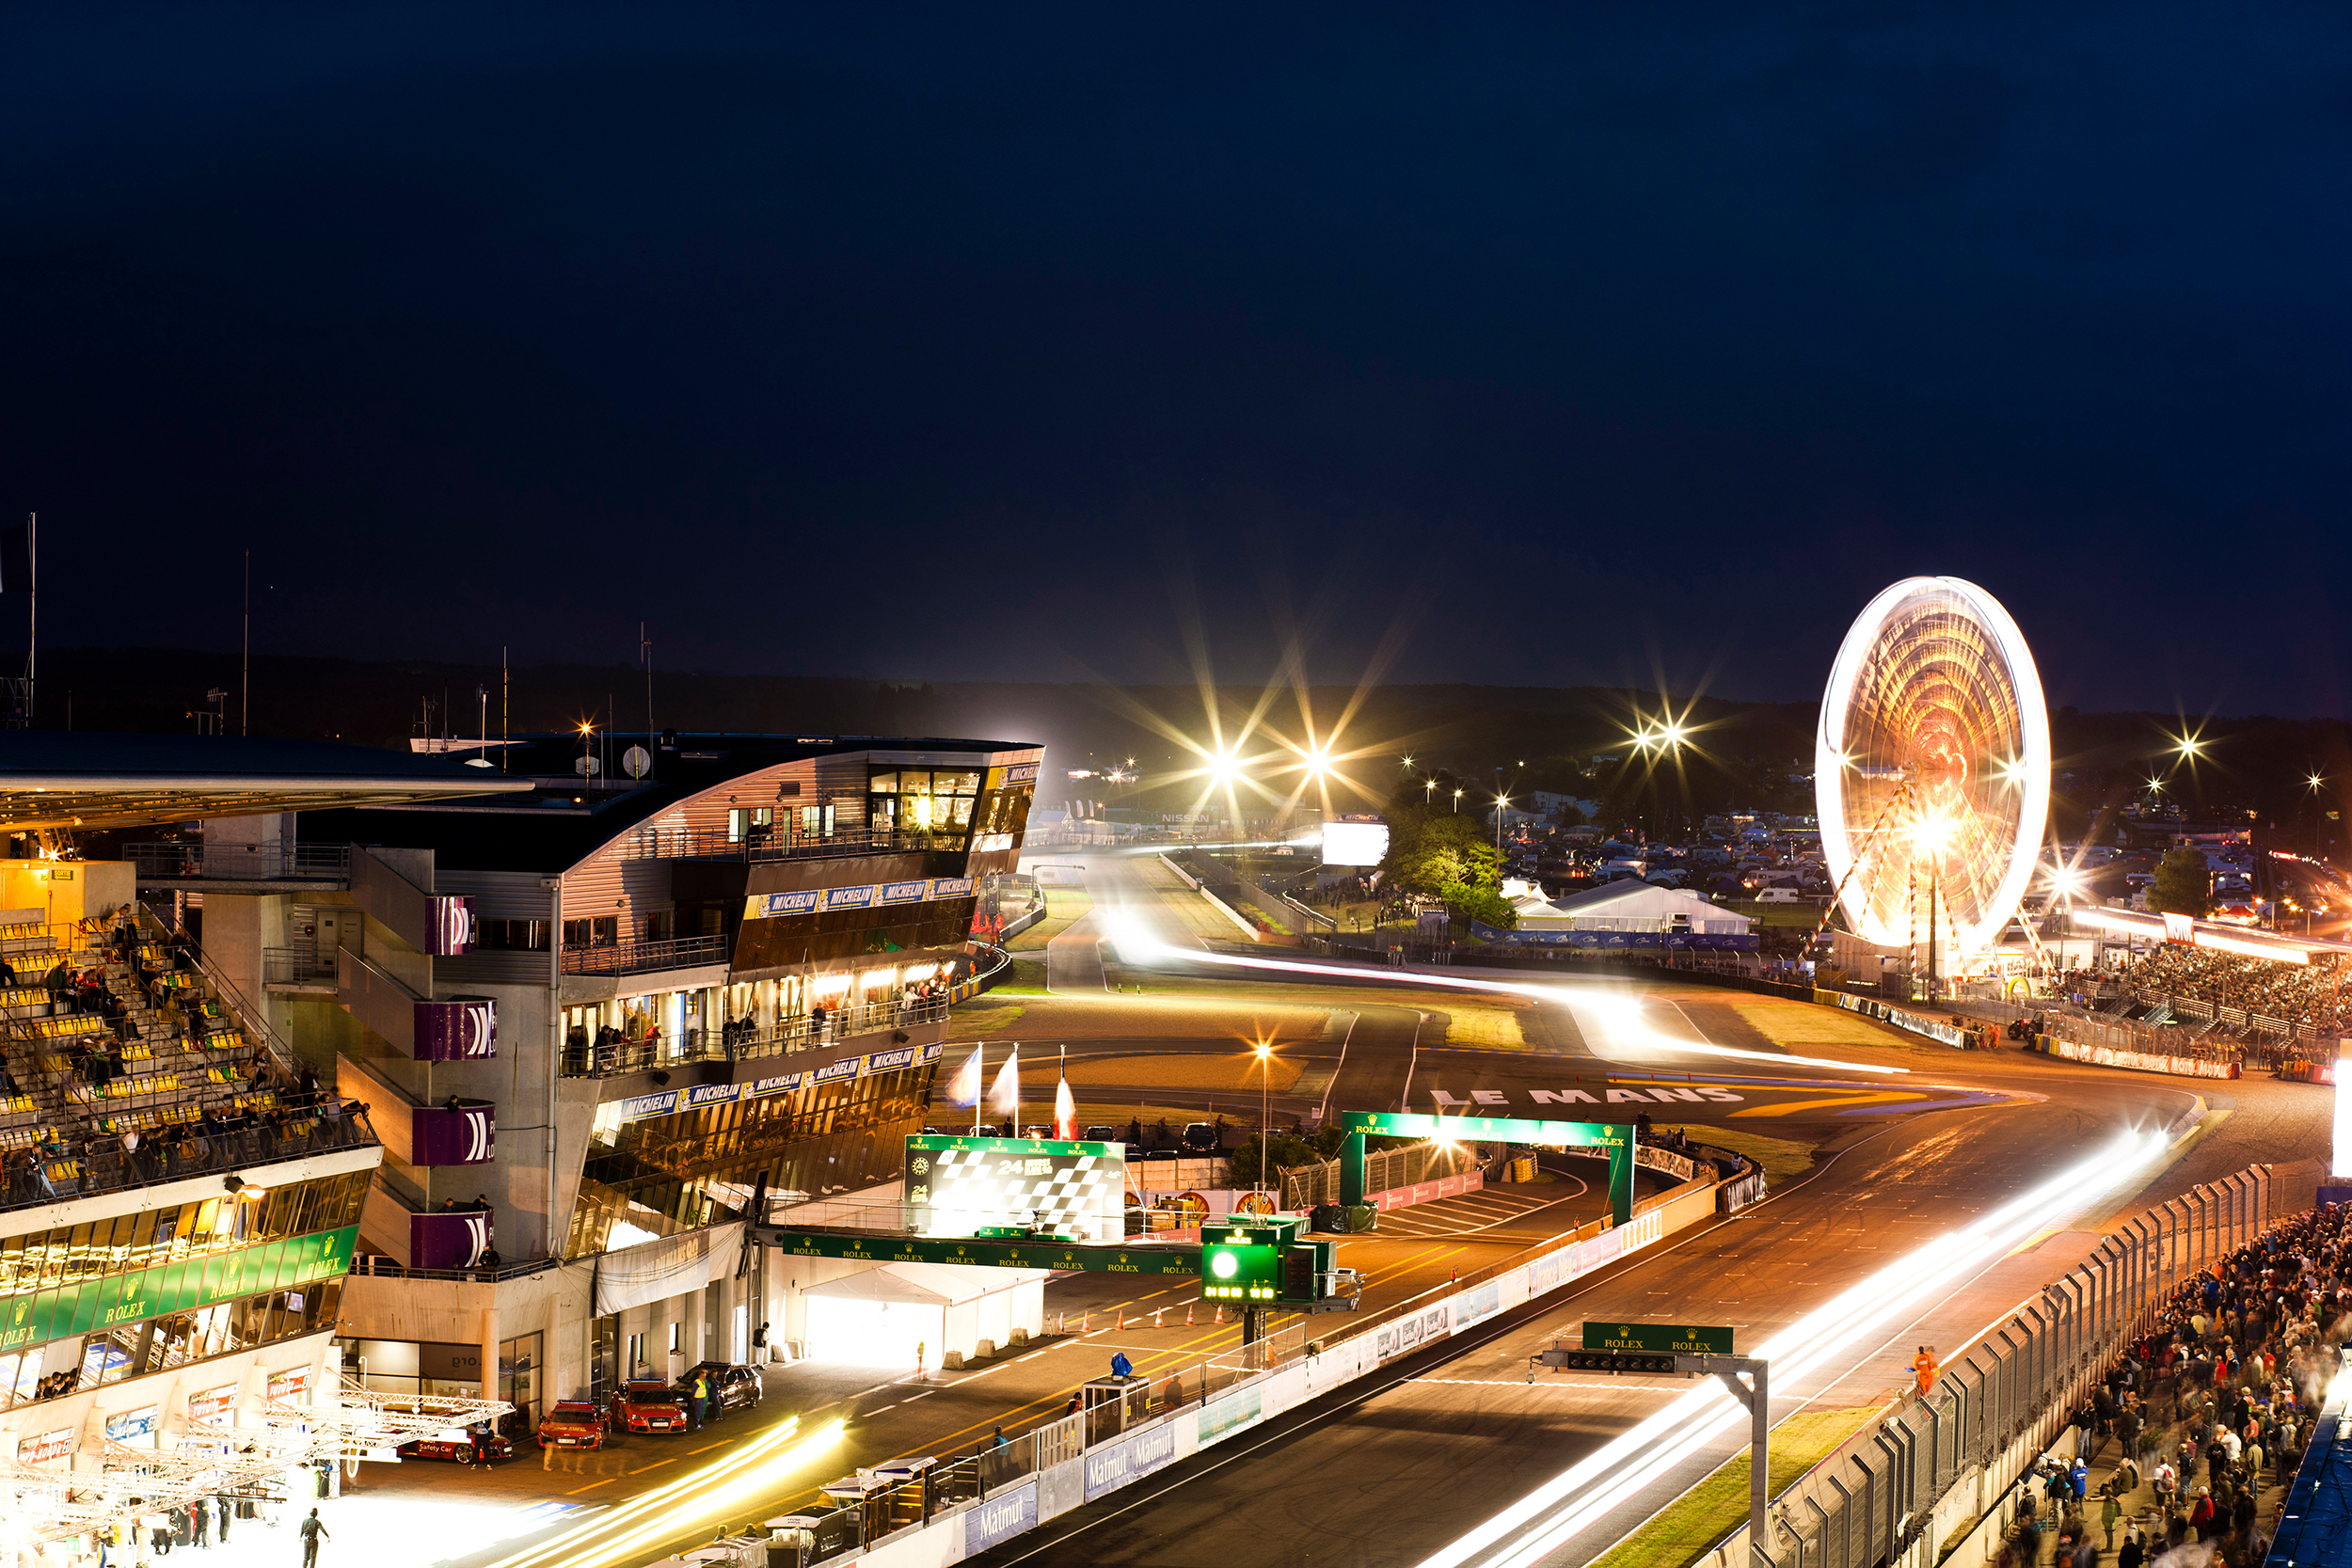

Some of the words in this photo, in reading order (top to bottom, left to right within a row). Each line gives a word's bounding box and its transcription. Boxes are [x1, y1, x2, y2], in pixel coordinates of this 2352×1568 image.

[1162, 814, 1209, 822] NISSAN
[885, 881, 925, 898] MICHELIN
[937, 878, 974, 894] MICHELIN
[772, 894, 817, 910] MICHELIN
[830, 888, 871, 905] MICHELIN
[872, 1049, 914, 1069] MICHELIN
[817, 1059, 859, 1079] MICHELIN
[756, 1072, 802, 1090] MICHELIN
[693, 1084, 740, 1103] MICHELIN
[1430, 1089, 1510, 1105] LE
[1528, 1087, 1745, 1104] MANS
[627, 1094, 675, 1115] MICHELIN
[1355, 1125, 1389, 1134] ROLEX
[1591, 1136, 1624, 1147] ROLEX
[997, 1160, 1024, 1176] 24
[912, 1184, 928, 1195] 24
[1225, 1236, 1252, 1244] ROLEX
[793, 1247, 821, 1256] ROLEX
[843, 1250, 872, 1259] ROLEX
[894, 1253, 924, 1262] ROLEX
[307, 1258, 341, 1277] ROLEX
[946, 1256, 976, 1265] ROLEX
[1053, 1261, 1084, 1270] ROLEX
[1107, 1264, 1138, 1273] ROLEX
[1163, 1266, 1194, 1275] ROLEX
[210, 1279, 246, 1300] ROLEX
[104, 1301, 146, 1323] ROLEX
[1604, 1338, 1643, 1349] ROLEX
[1672, 1341, 1710, 1352] ROLEX
[269, 1379, 294, 1397] TOYOTA
[192, 1400, 220, 1418] TOYOTA
[419, 1443, 439, 1453] Safety
[1135, 1431, 1172, 1468] Matmut
[1088, 1449, 1127, 1489] Matmut
[980, 1494, 1024, 1541] Matmut
